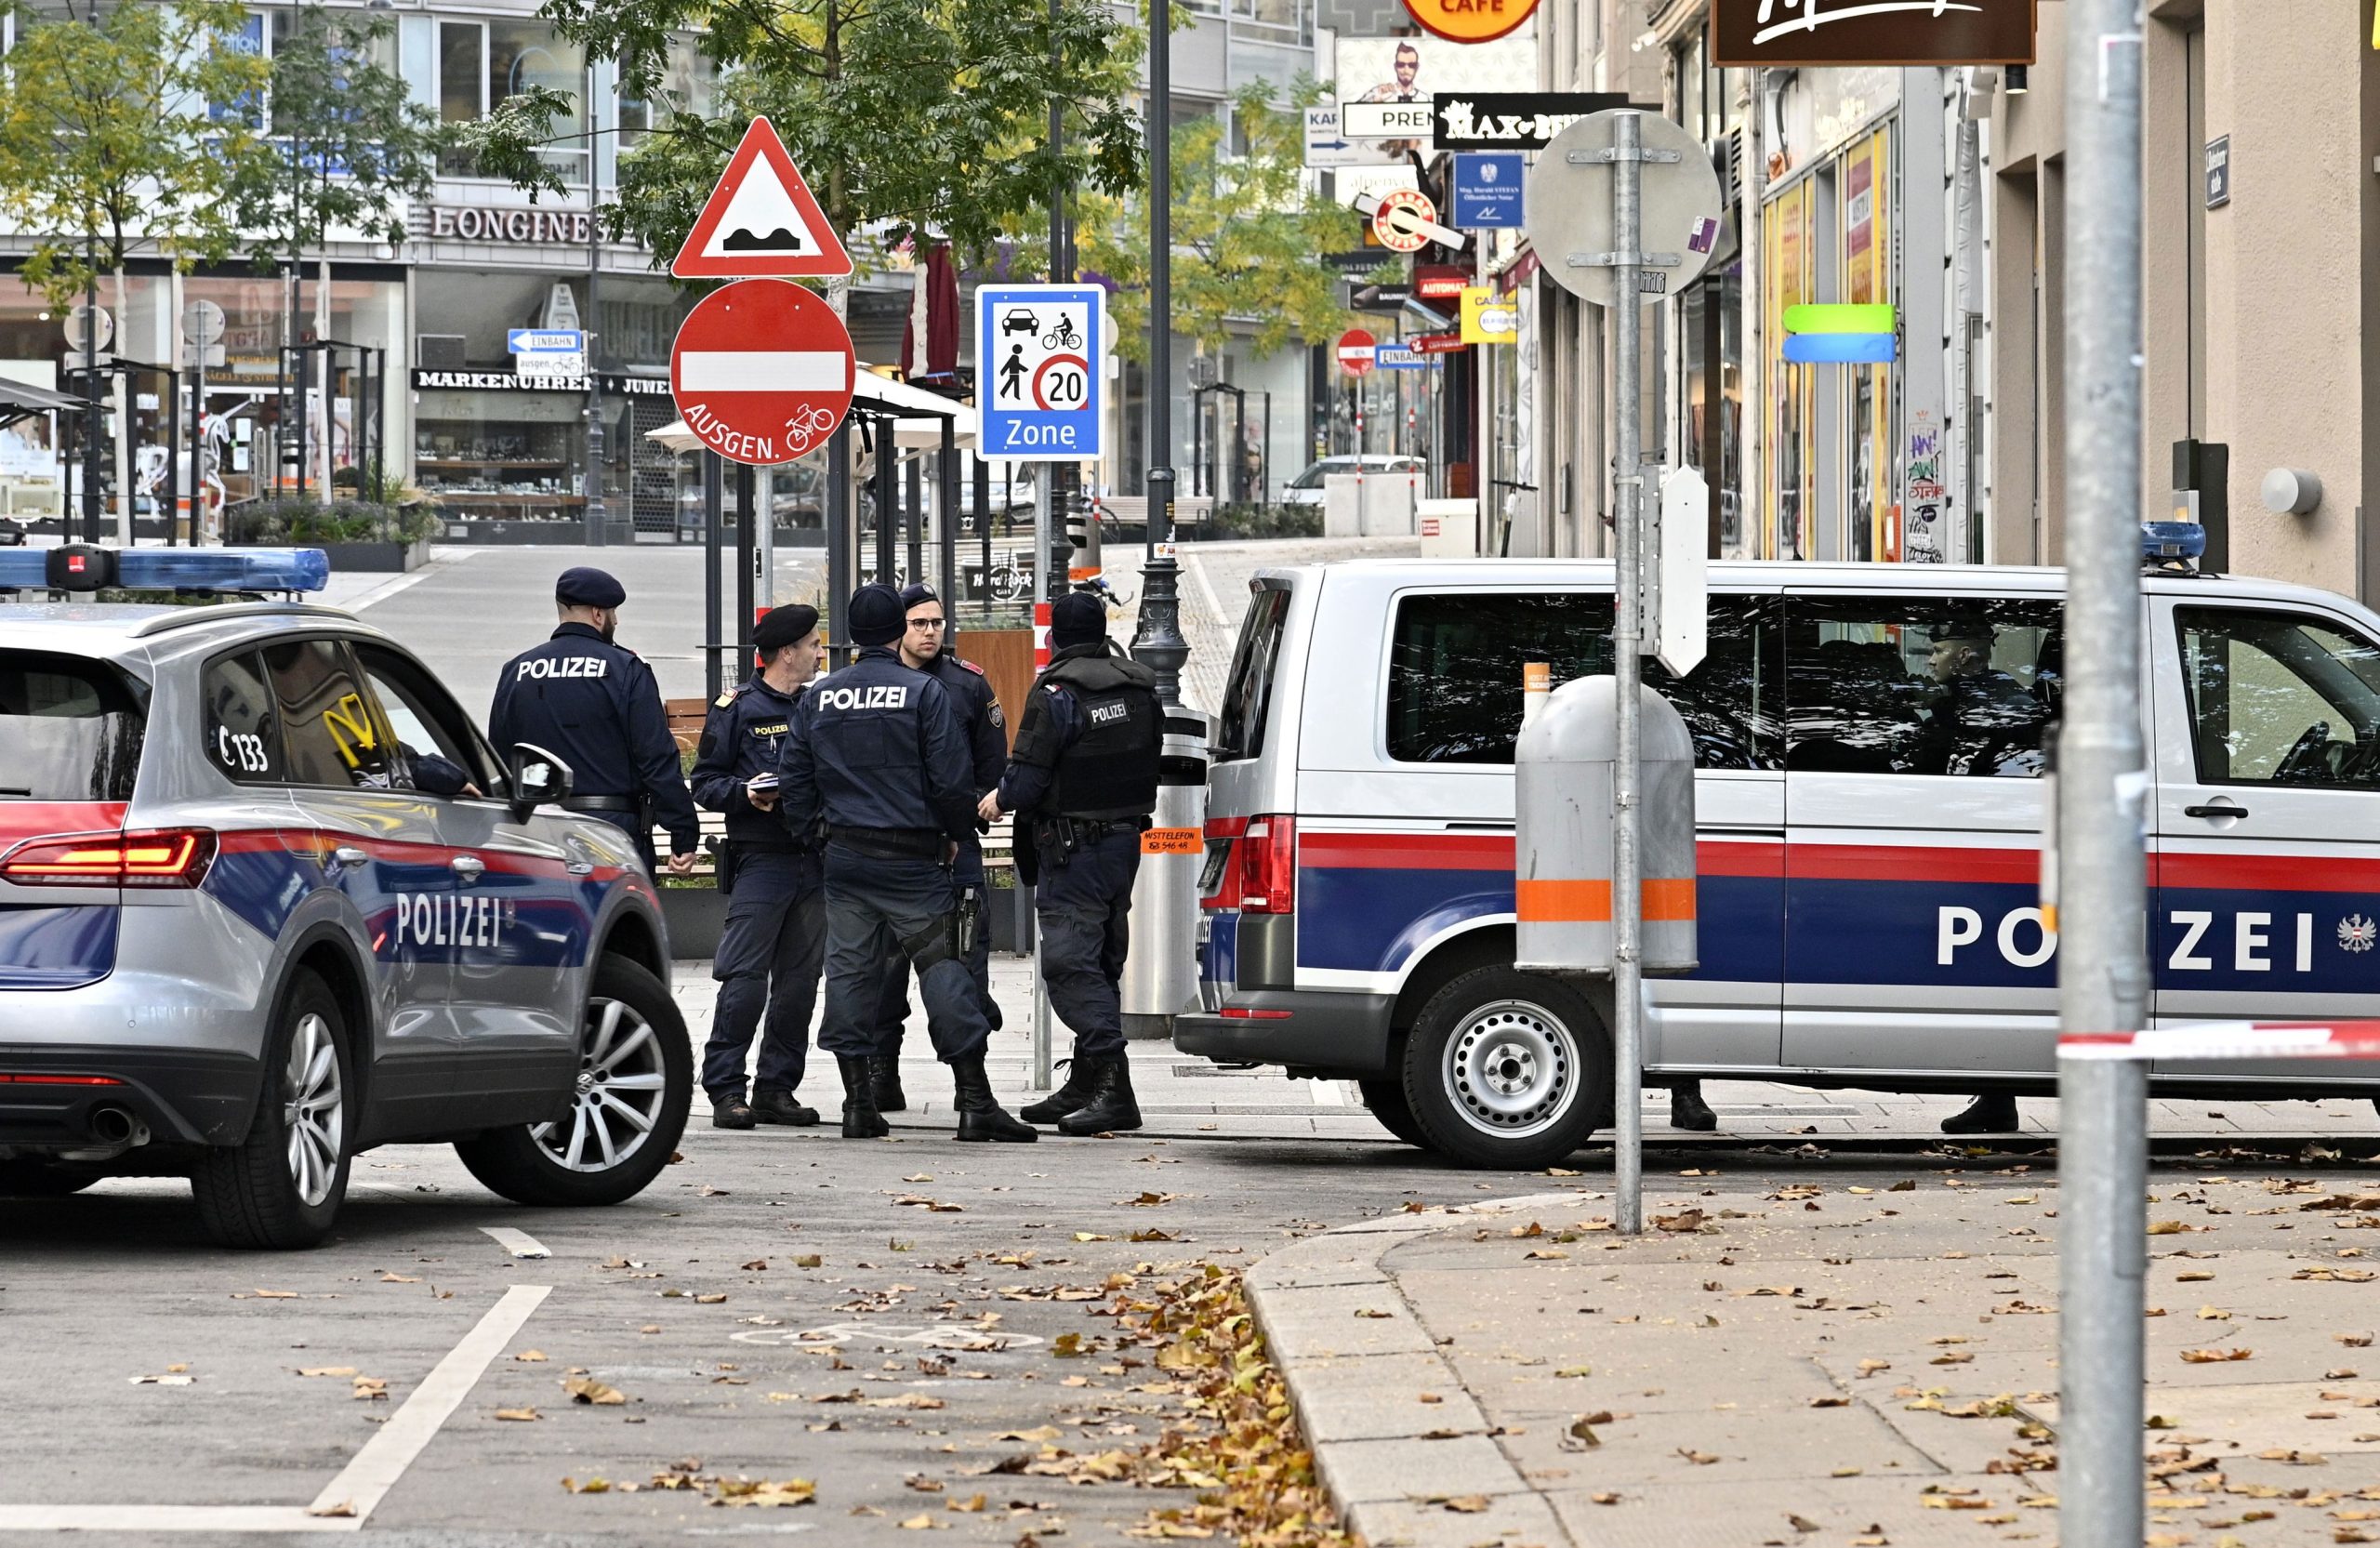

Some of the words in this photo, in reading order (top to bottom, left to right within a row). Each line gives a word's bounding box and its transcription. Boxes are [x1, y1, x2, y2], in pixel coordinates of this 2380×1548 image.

[1444, 108, 1522, 139] MAX
[1421, 283, 1466, 294] AUTOMAT
[532, 337, 573, 347] EINBAHN
[520, 359, 551, 369] ausgen.
[419, 372, 592, 391] MARKENUHREN
[623, 377, 672, 394] JUWE
[1050, 372, 1081, 402] 20
[684, 404, 780, 459] AUSGEN.
[1006, 419, 1076, 445] Zone
[517, 656, 607, 681] POLIZEI
[819, 686, 907, 711] POLIZEI
[1091, 703, 1127, 723] POLIZEI
[755, 724, 788, 735] POLIZEI
[231, 734, 268, 772] 133
[1144, 831, 1195, 840] MISTTELEFON
[1162, 841, 1176, 850] 546
[1178, 841, 1188, 850] 48
[397, 893, 500, 947] POLIZEI
[1937, 906, 2312, 972] POZEI
